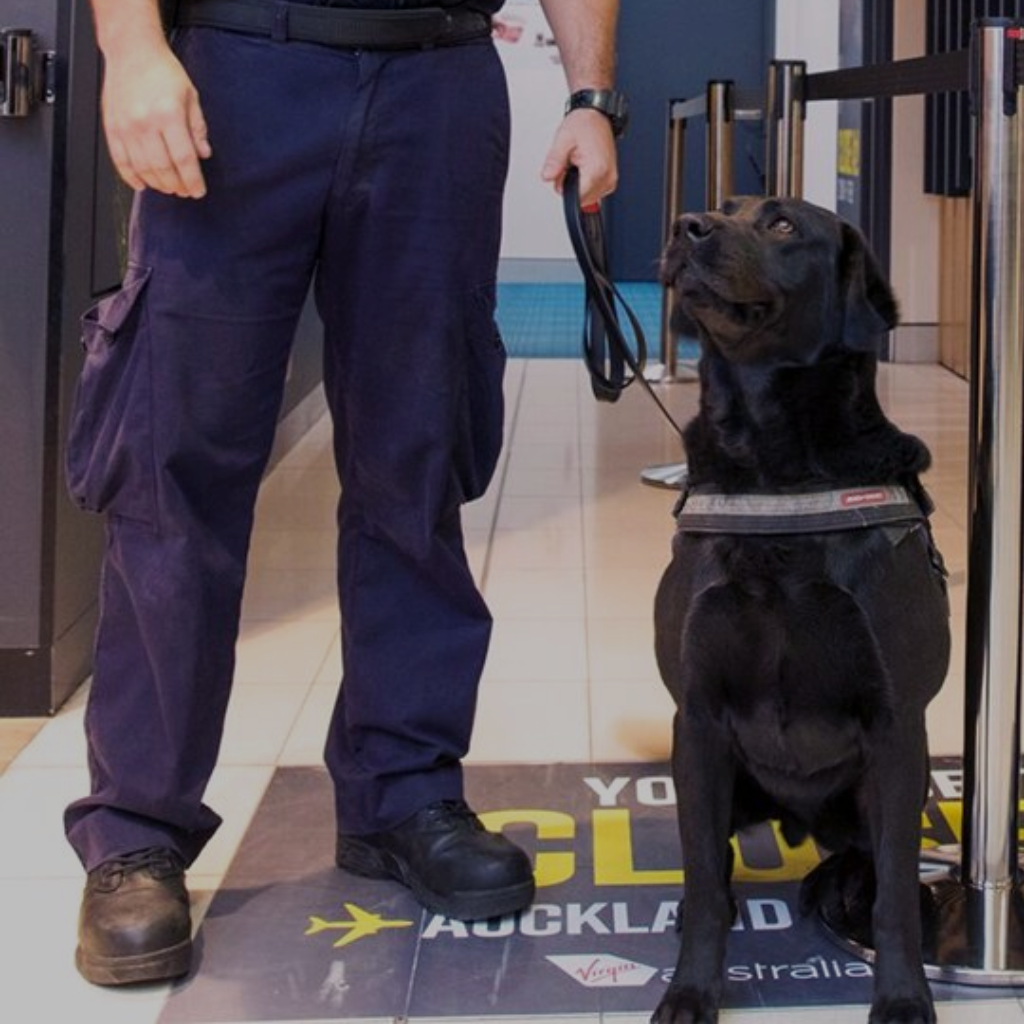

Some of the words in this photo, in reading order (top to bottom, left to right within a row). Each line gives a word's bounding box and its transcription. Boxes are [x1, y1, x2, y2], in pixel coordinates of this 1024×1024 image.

[421, 898, 793, 939] AUCKLAD
[576, 958, 638, 983] Virgin
[661, 955, 875, 983] astralia
